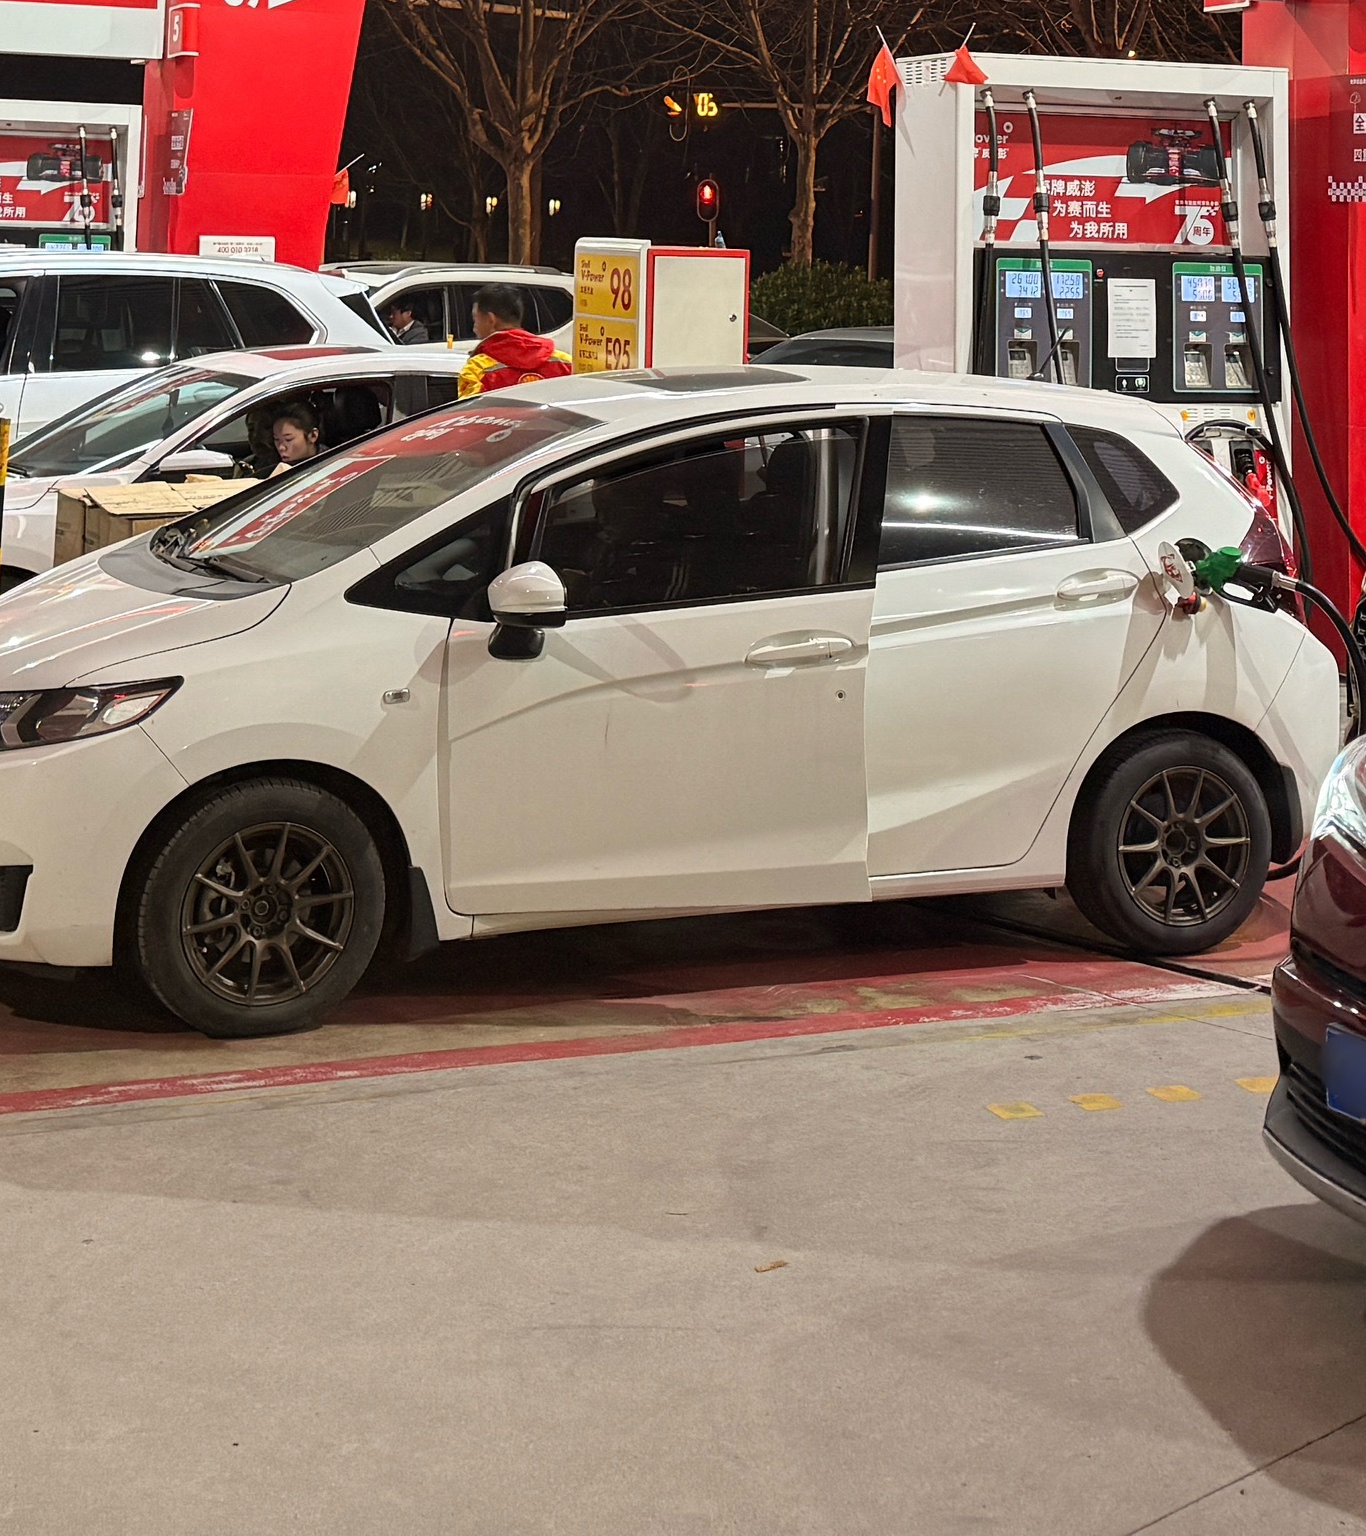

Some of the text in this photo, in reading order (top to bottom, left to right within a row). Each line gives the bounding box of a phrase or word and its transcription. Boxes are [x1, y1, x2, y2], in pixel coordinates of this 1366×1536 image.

[172, 15, 180, 42] 5
[1052, 199, 1112, 218] 为赛而生
[1069, 220, 1129, 239] 为我所用
[581, 267, 632, 312] V-Power 98
[579, 333, 603, 346] V-Power
[605, 336, 631, 371] E95
